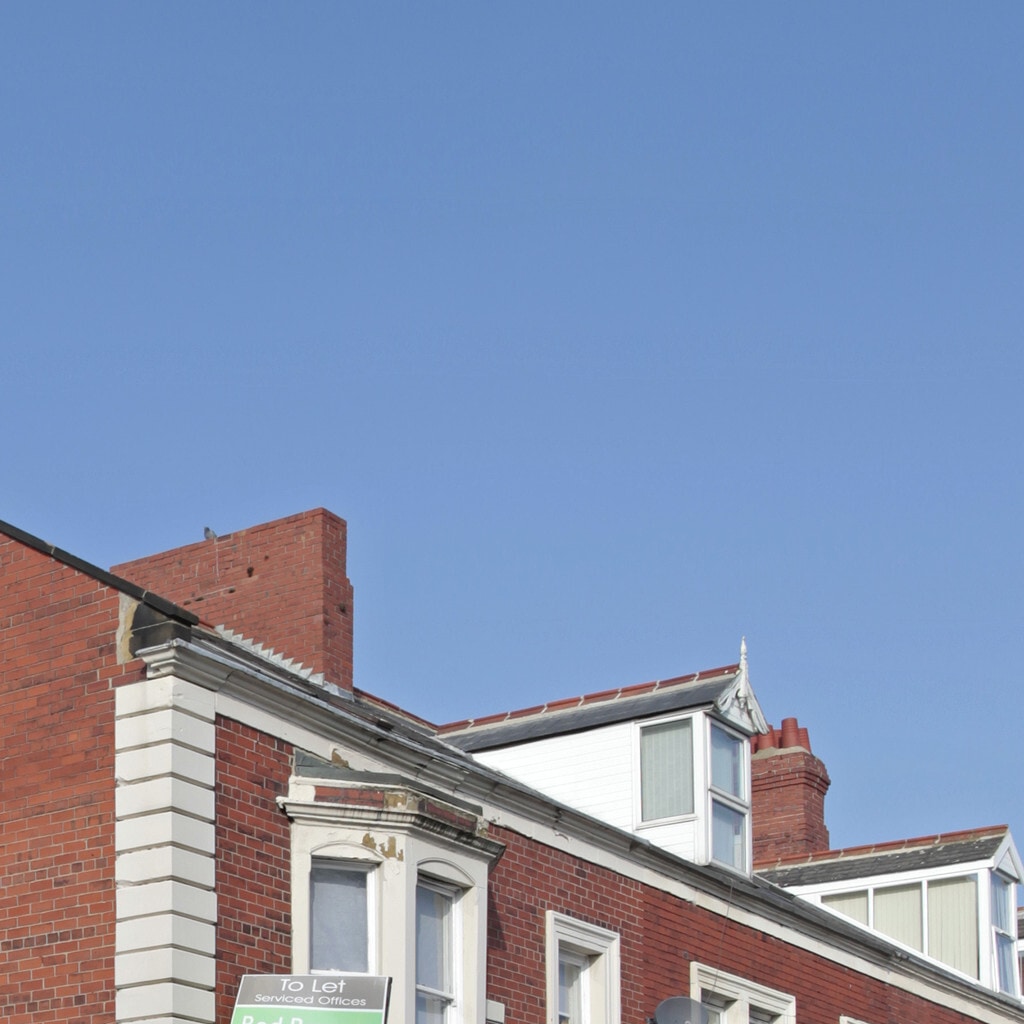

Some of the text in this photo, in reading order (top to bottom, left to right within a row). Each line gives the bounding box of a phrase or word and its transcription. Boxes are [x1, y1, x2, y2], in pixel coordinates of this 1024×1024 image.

[280, 978, 346, 993] To Let
[254, 993, 366, 1006] Serviced Offices
